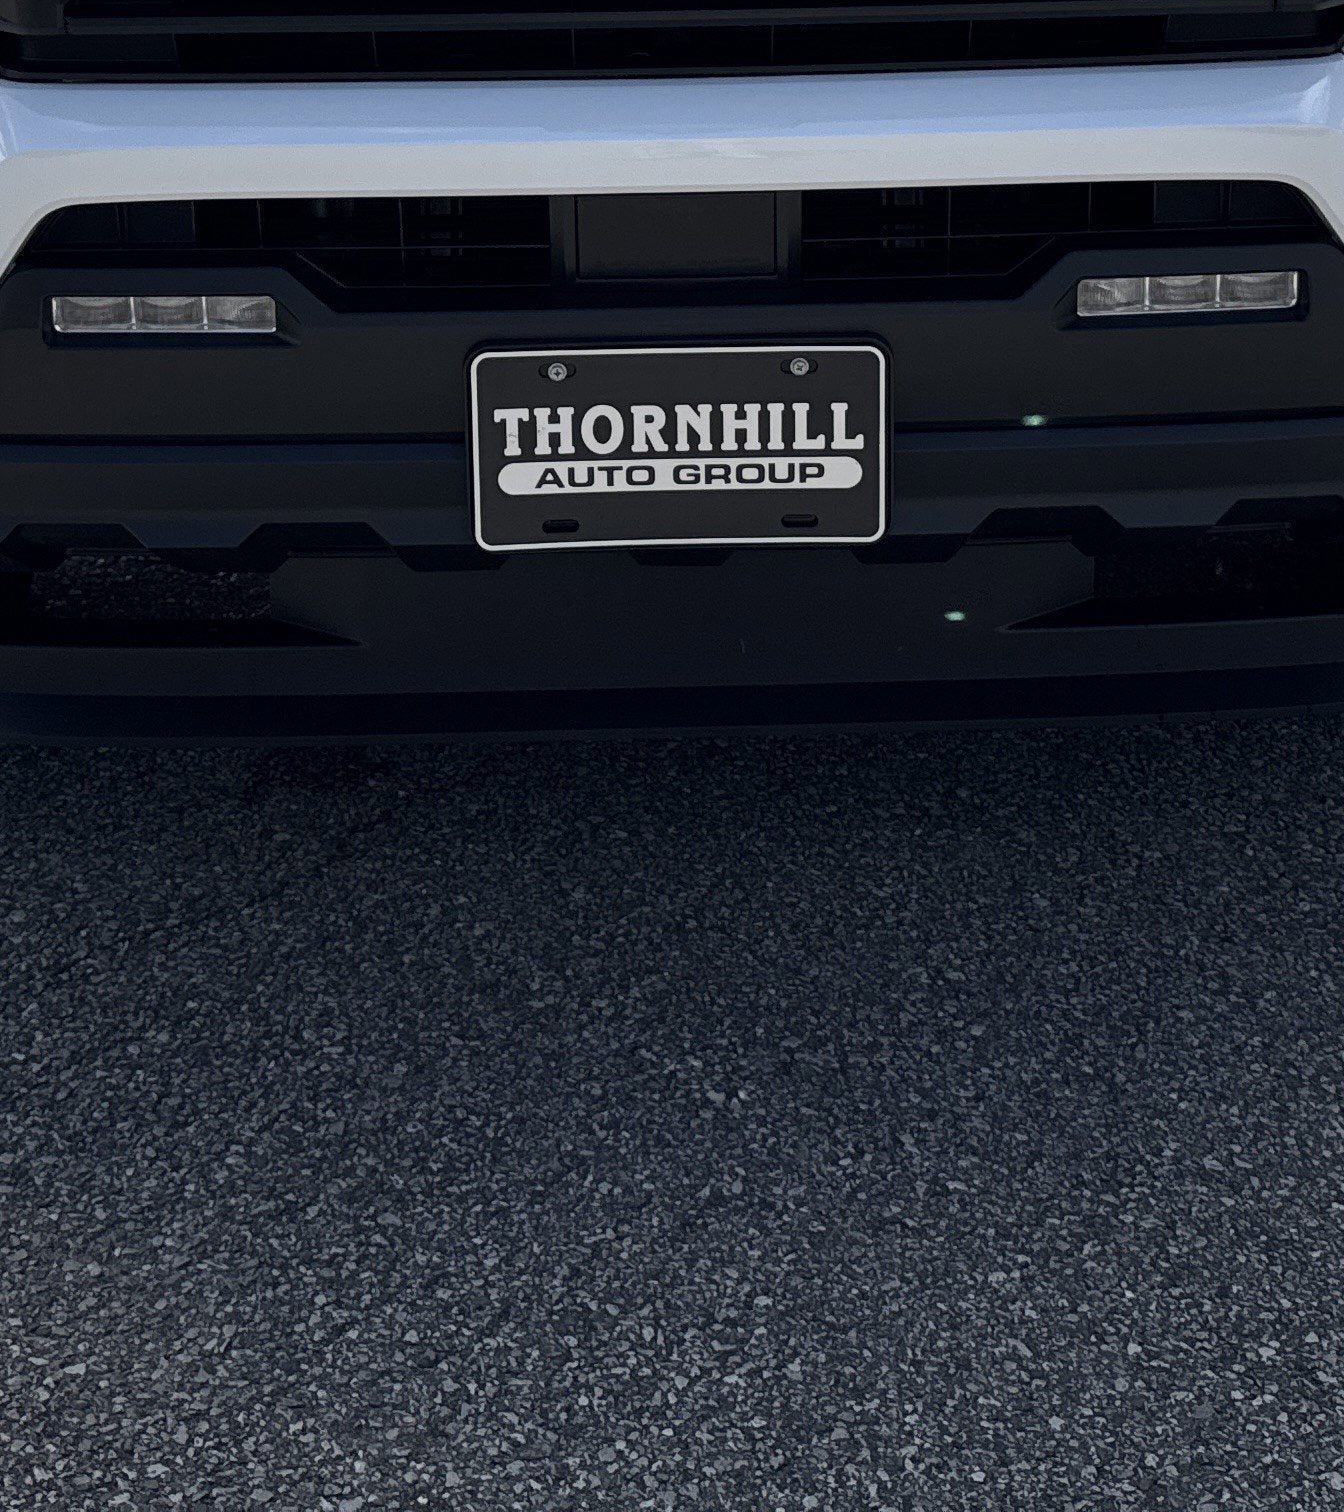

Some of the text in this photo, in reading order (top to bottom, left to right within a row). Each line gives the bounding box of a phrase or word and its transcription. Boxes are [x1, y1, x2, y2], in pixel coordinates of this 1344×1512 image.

[494, 402, 864, 456] THORNHILL
[535, 463, 825, 489] AUTO GROUP
